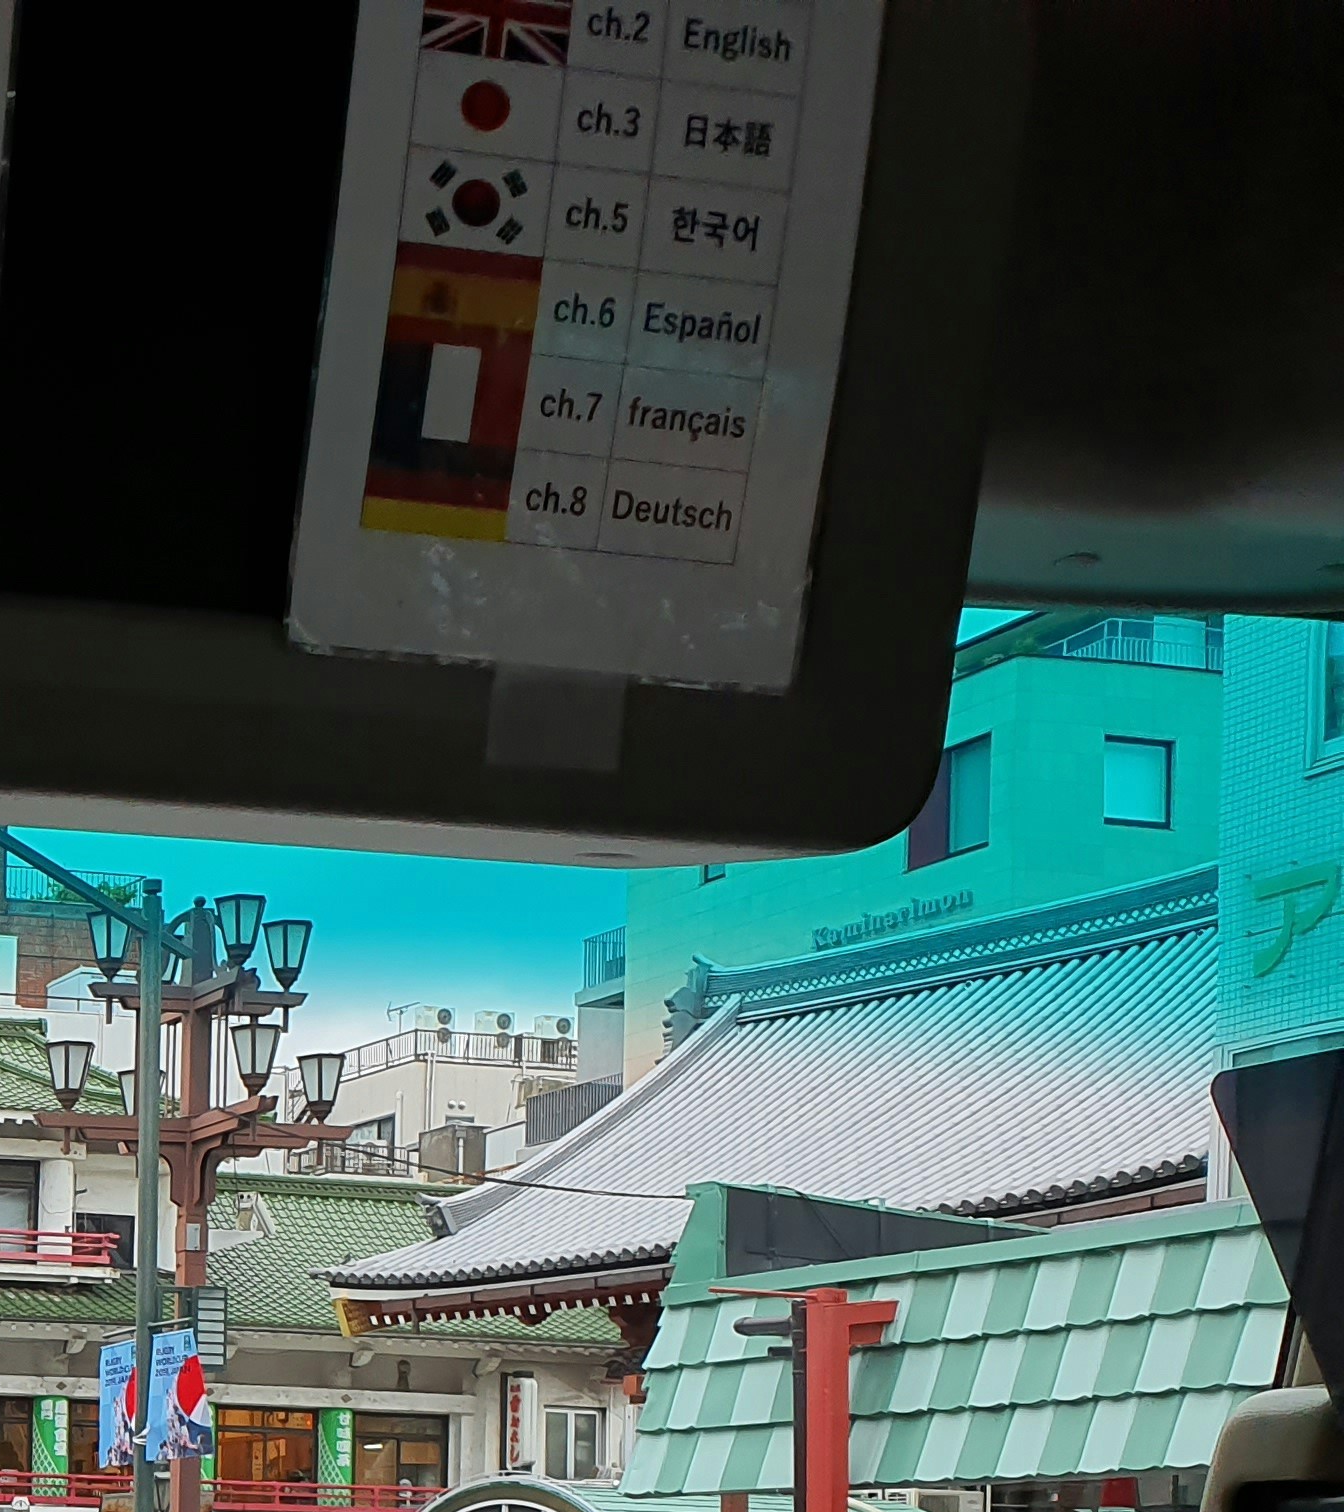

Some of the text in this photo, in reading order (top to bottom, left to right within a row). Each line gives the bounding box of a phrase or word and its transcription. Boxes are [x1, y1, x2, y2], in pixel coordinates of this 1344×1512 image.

[587, 10, 791, 62] ch.2 English
[576, 103, 773, 159] ch.3 日本語
[565, 197, 761, 252] ch.5 한국어
[553, 293, 761, 346] ch.6 Español
[539, 389, 746, 441] ch.7 français
[525, 483, 733, 532] ch.8 Deutsch
